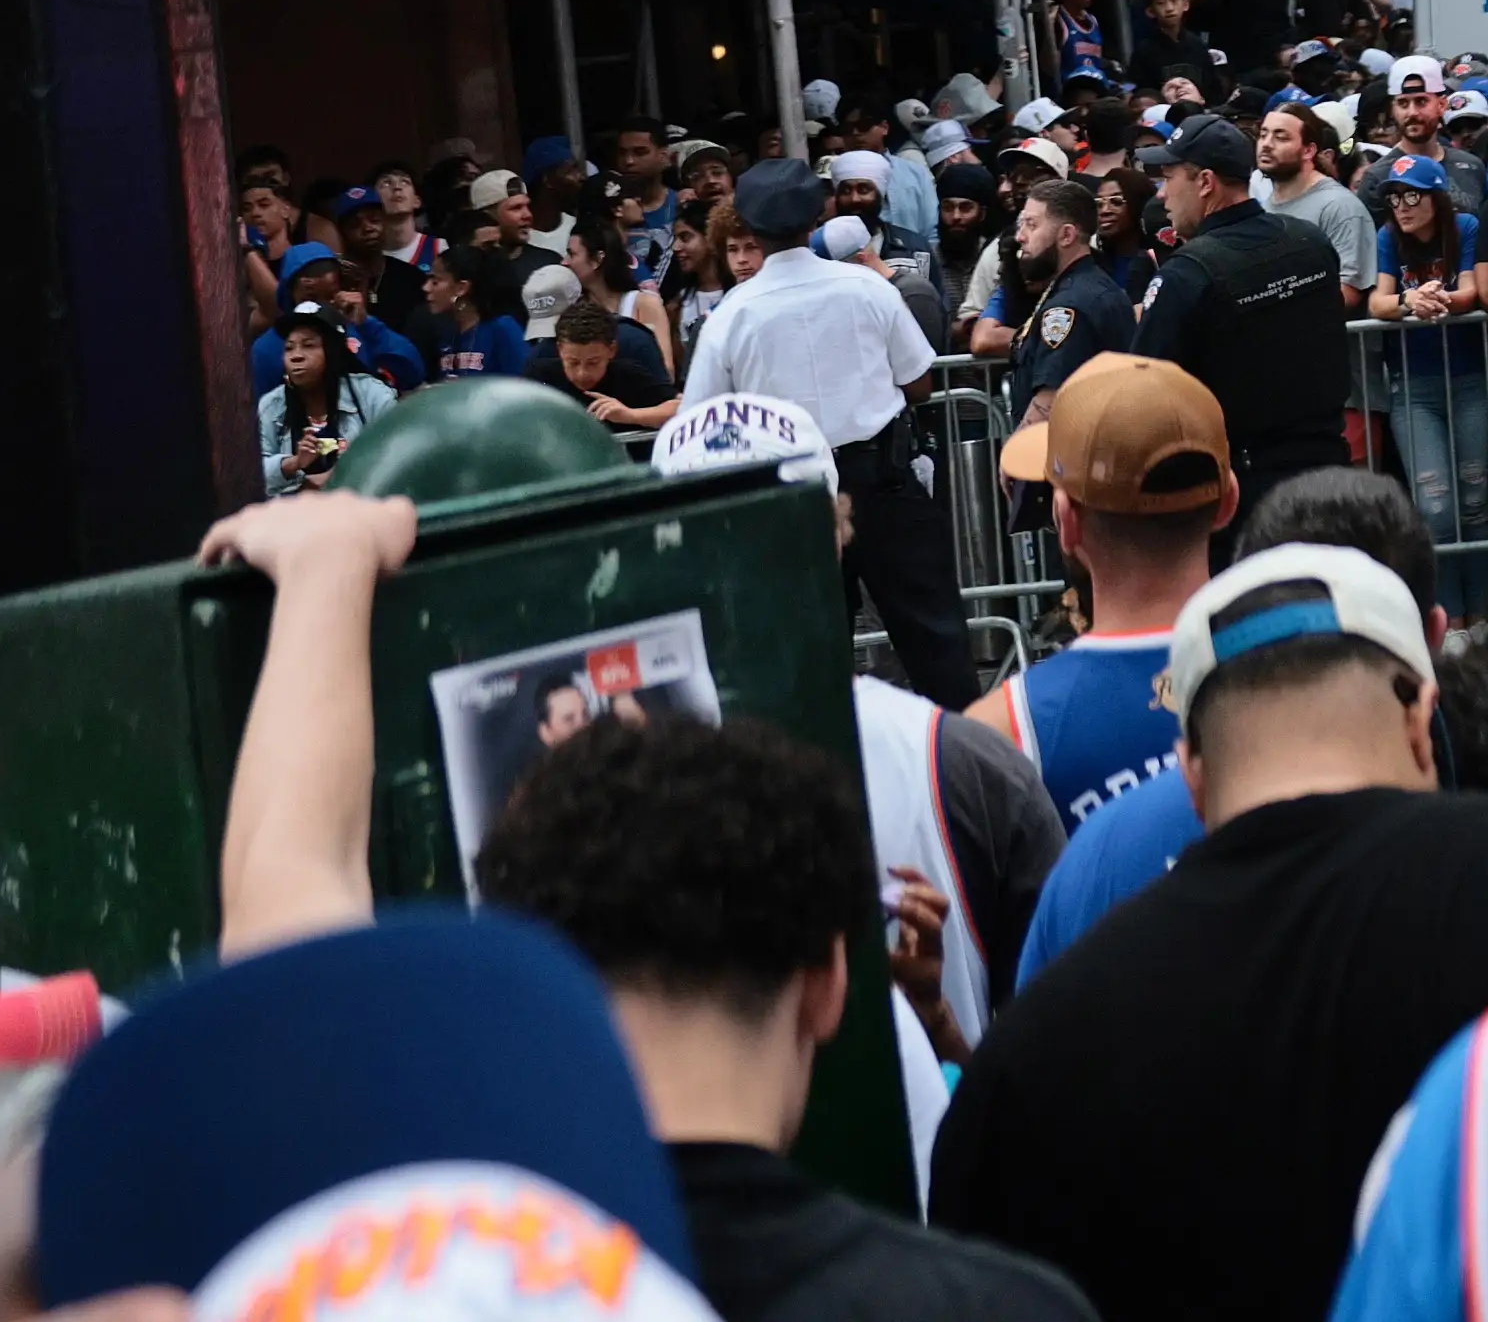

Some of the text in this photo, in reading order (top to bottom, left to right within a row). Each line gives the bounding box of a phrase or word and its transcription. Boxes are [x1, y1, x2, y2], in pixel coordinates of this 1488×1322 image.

[1237, 271, 1327, 306] TRANSIT BUREAU
[1267, 275, 1298, 289] NYPD
[669, 400, 797, 455] GIANTS
